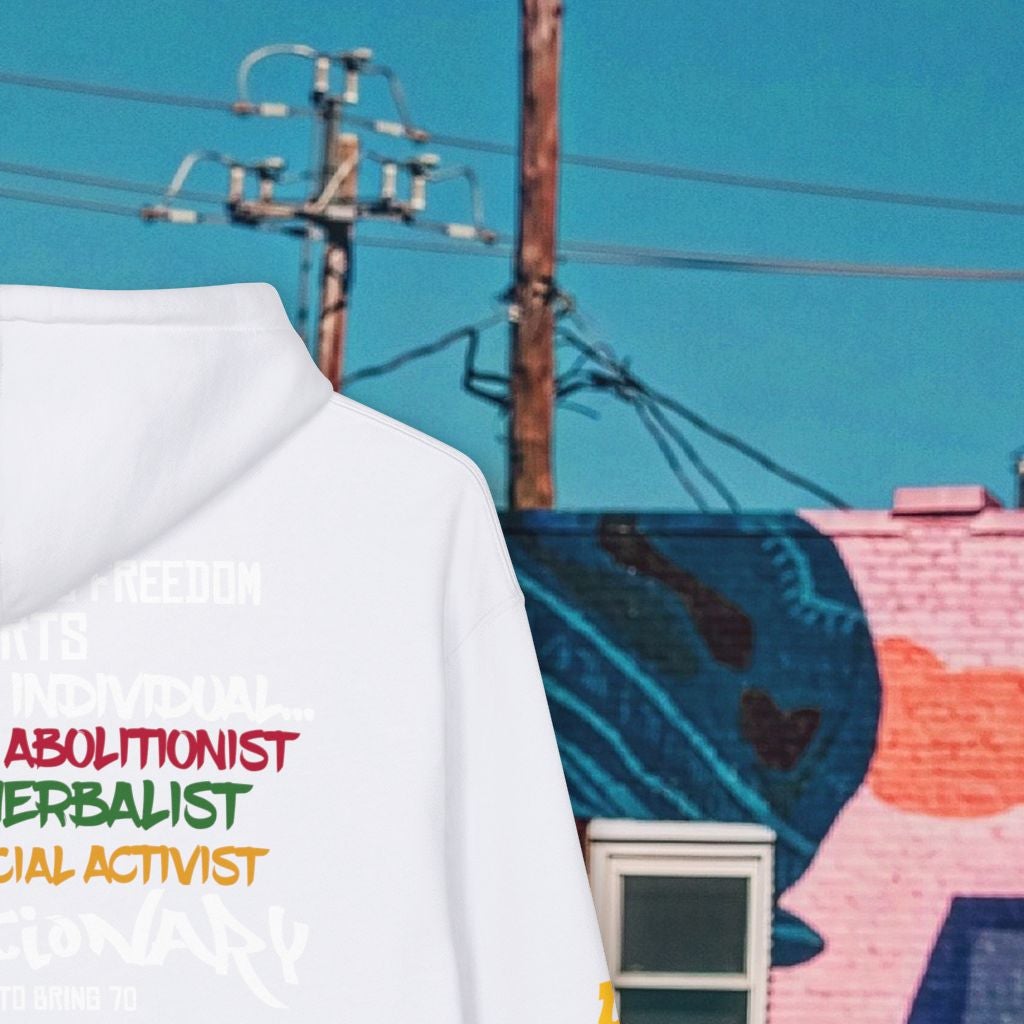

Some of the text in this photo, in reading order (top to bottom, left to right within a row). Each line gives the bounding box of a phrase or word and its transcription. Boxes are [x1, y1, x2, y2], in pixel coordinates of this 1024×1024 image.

[4, 726, 300, 772] ABOLITIONIST
[82, 845, 270, 887] ACTIVIST
[33, 985, 101, 1011] BRING
[108, 985, 138, 1011] 70
